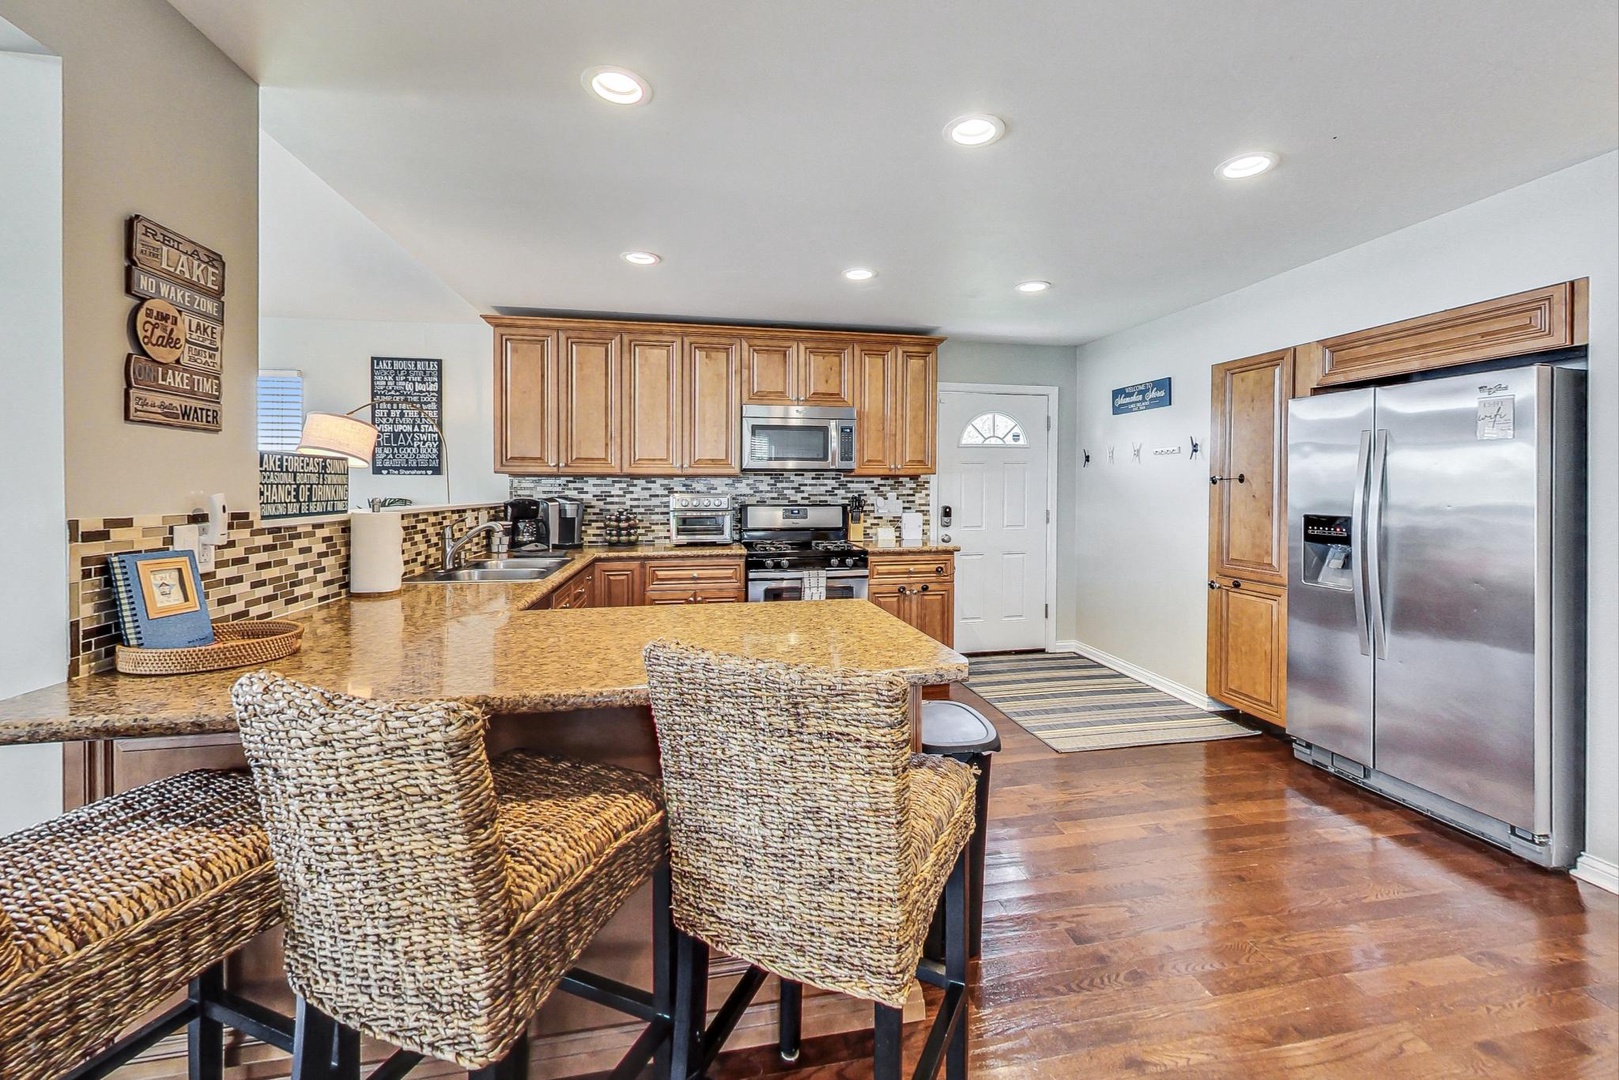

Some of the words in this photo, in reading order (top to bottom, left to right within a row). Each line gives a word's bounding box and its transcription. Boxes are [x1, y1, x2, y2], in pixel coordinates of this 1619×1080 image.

[142, 224, 219, 269] RELAX
[161, 246, 219, 290] LAKE
[140, 275, 156, 293] NO
[159, 282, 191, 306] WAKE
[193, 296, 219, 316] ZONE
[145, 307, 154, 319] GO
[154, 311, 171, 323] JUMP
[142, 320, 183, 350] Lake
[188, 319, 217, 340] LAKE
[188, 333, 217, 346] LIFE
[188, 355, 218, 368] BOAT
[374, 360, 392, 370] LAKE
[393, 360, 416, 370] HOUSE
[417, 361, 438, 371] RULES
[135, 363, 154, 382] ON
[158, 367, 190, 389] LAKE
[193, 375, 219, 395] TIME
[179, 404, 219, 425] WATER
[394, 424, 413, 432] UPON
[376, 433, 414, 446] RELAX
[414, 433, 438, 441] SWIM
[283, 456, 325, 473] FORECAST:
[299, 484, 311, 502] OF
[312, 485, 348, 501] DRINKING
[287, 503, 300, 514] MAY
[301, 502, 309, 513] BE
[309, 502, 327, 512] HEAVY
